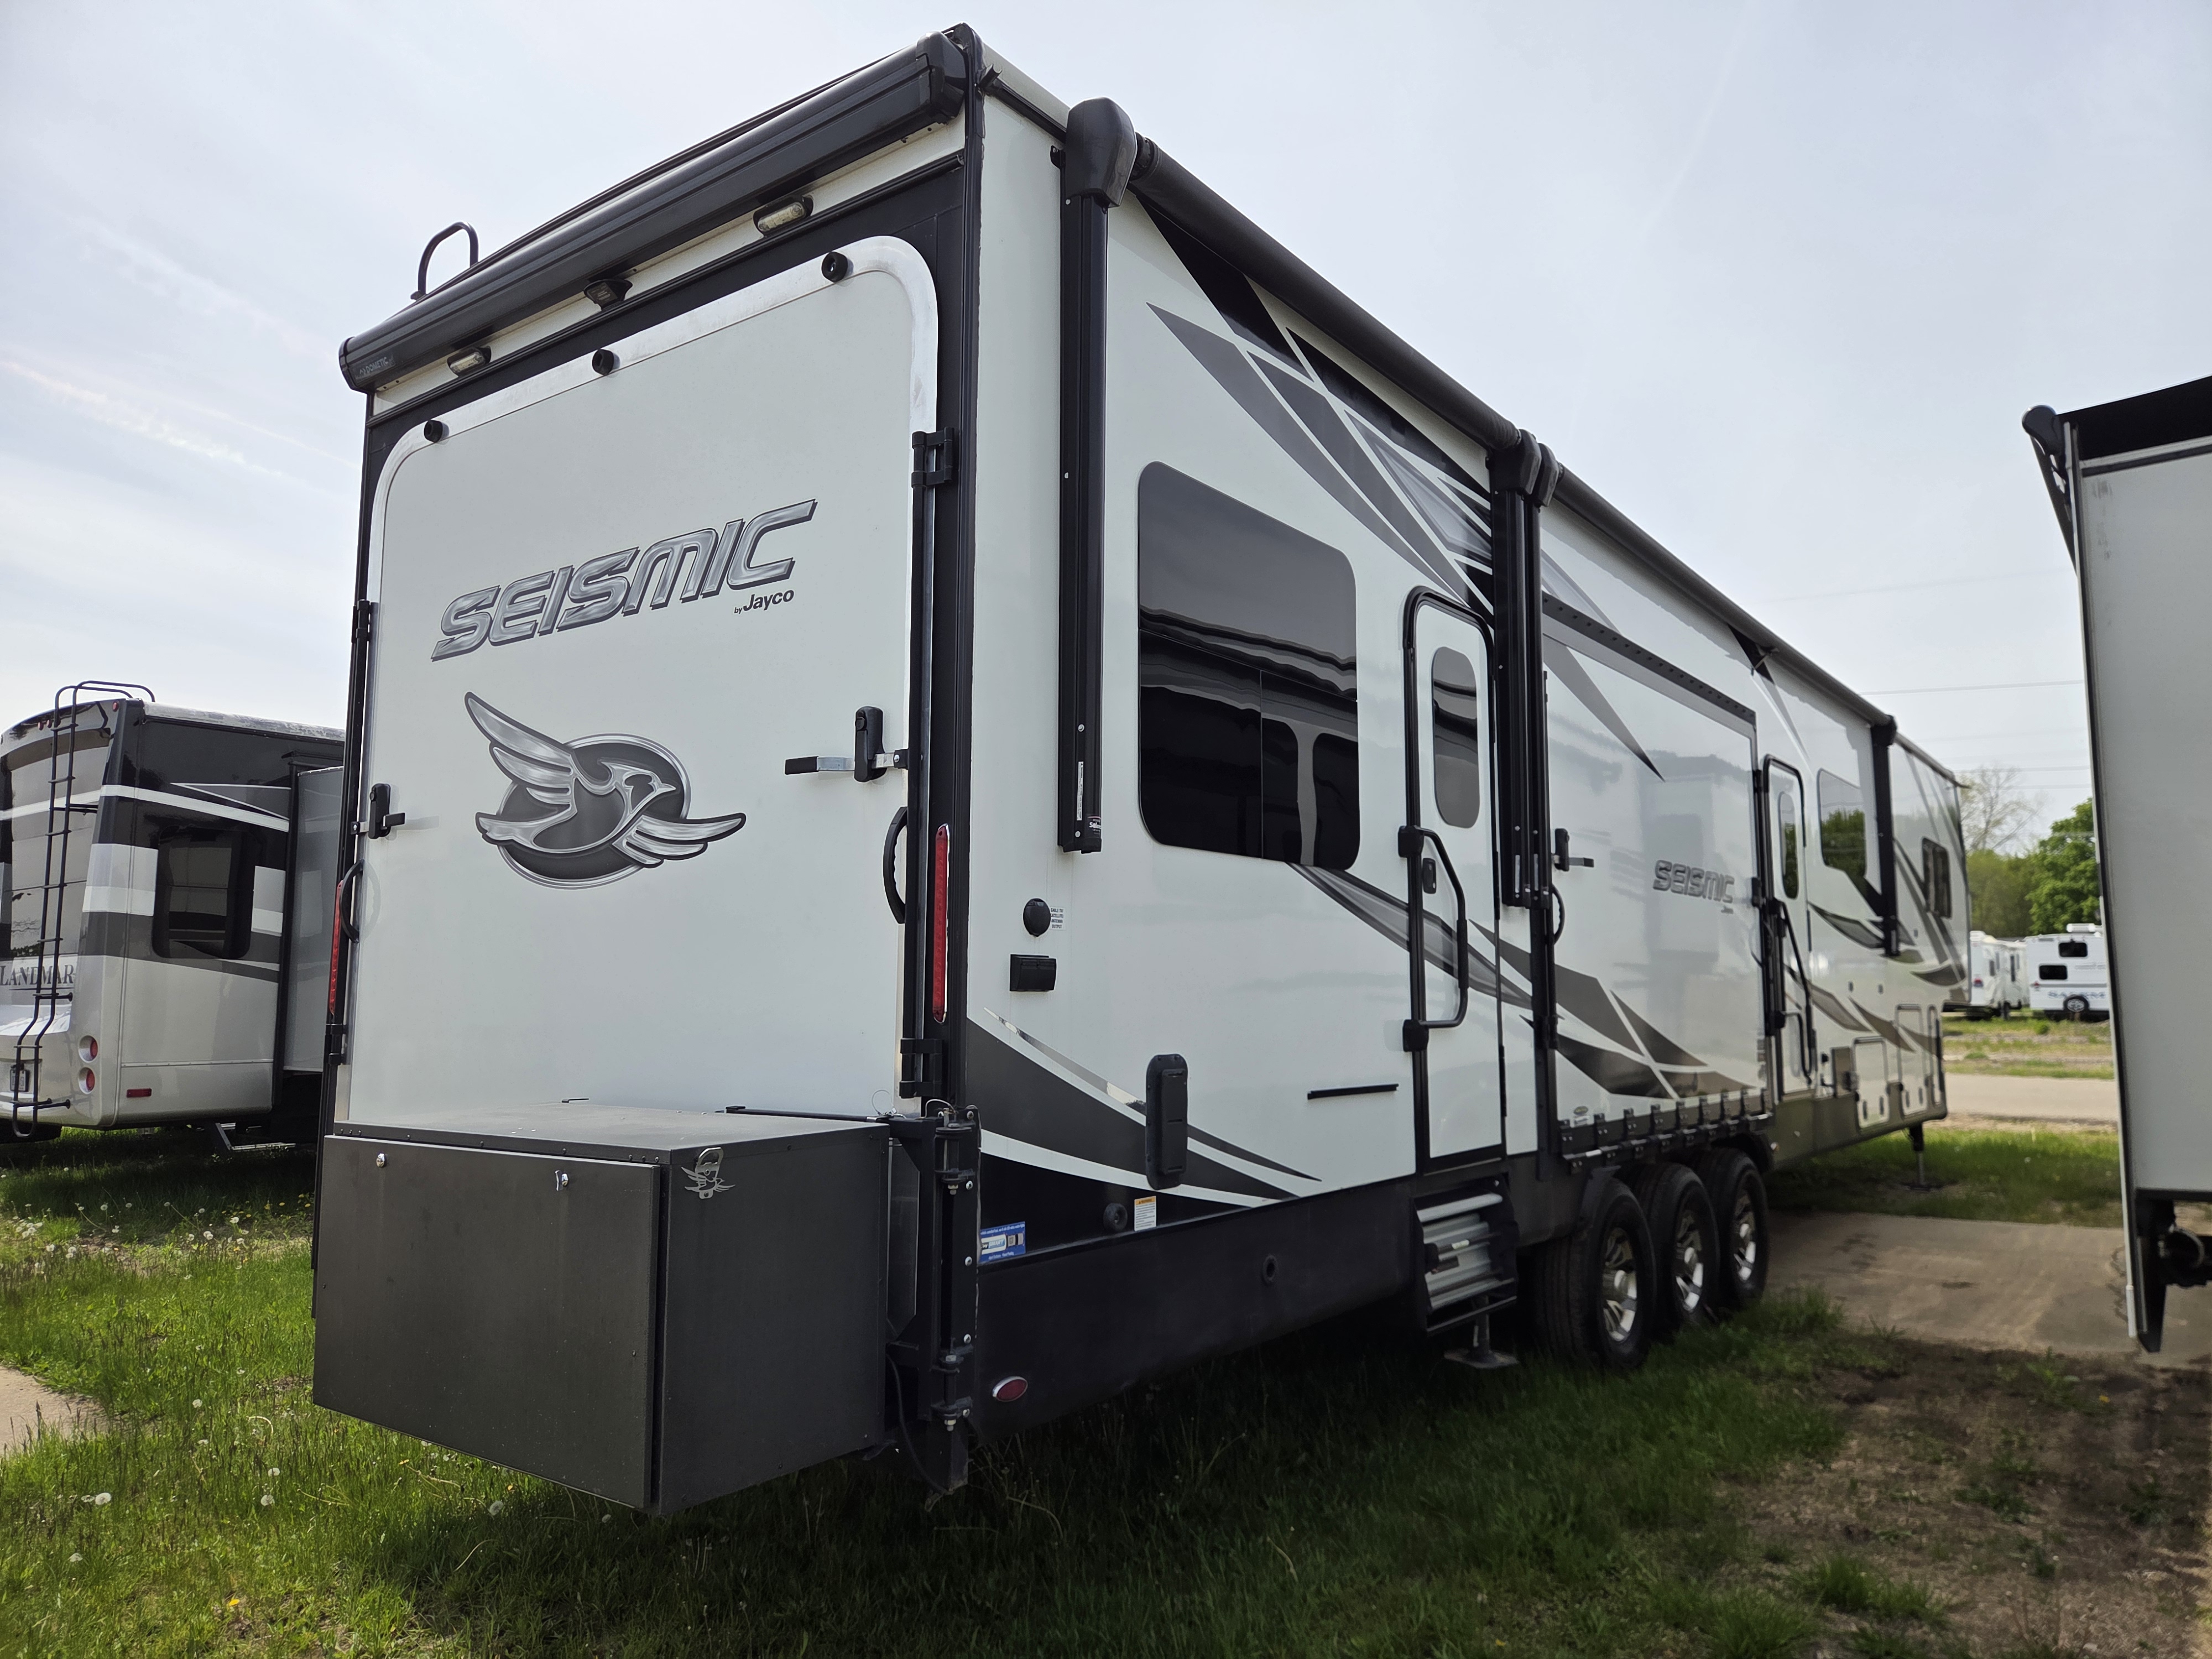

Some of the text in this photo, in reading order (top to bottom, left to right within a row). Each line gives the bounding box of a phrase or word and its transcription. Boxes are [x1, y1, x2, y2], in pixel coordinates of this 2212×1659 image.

[431, 499, 818, 662] SEISMIC
[743, 590, 794, 612] Jayco
[1652, 860, 1735, 903] SEISMIC
